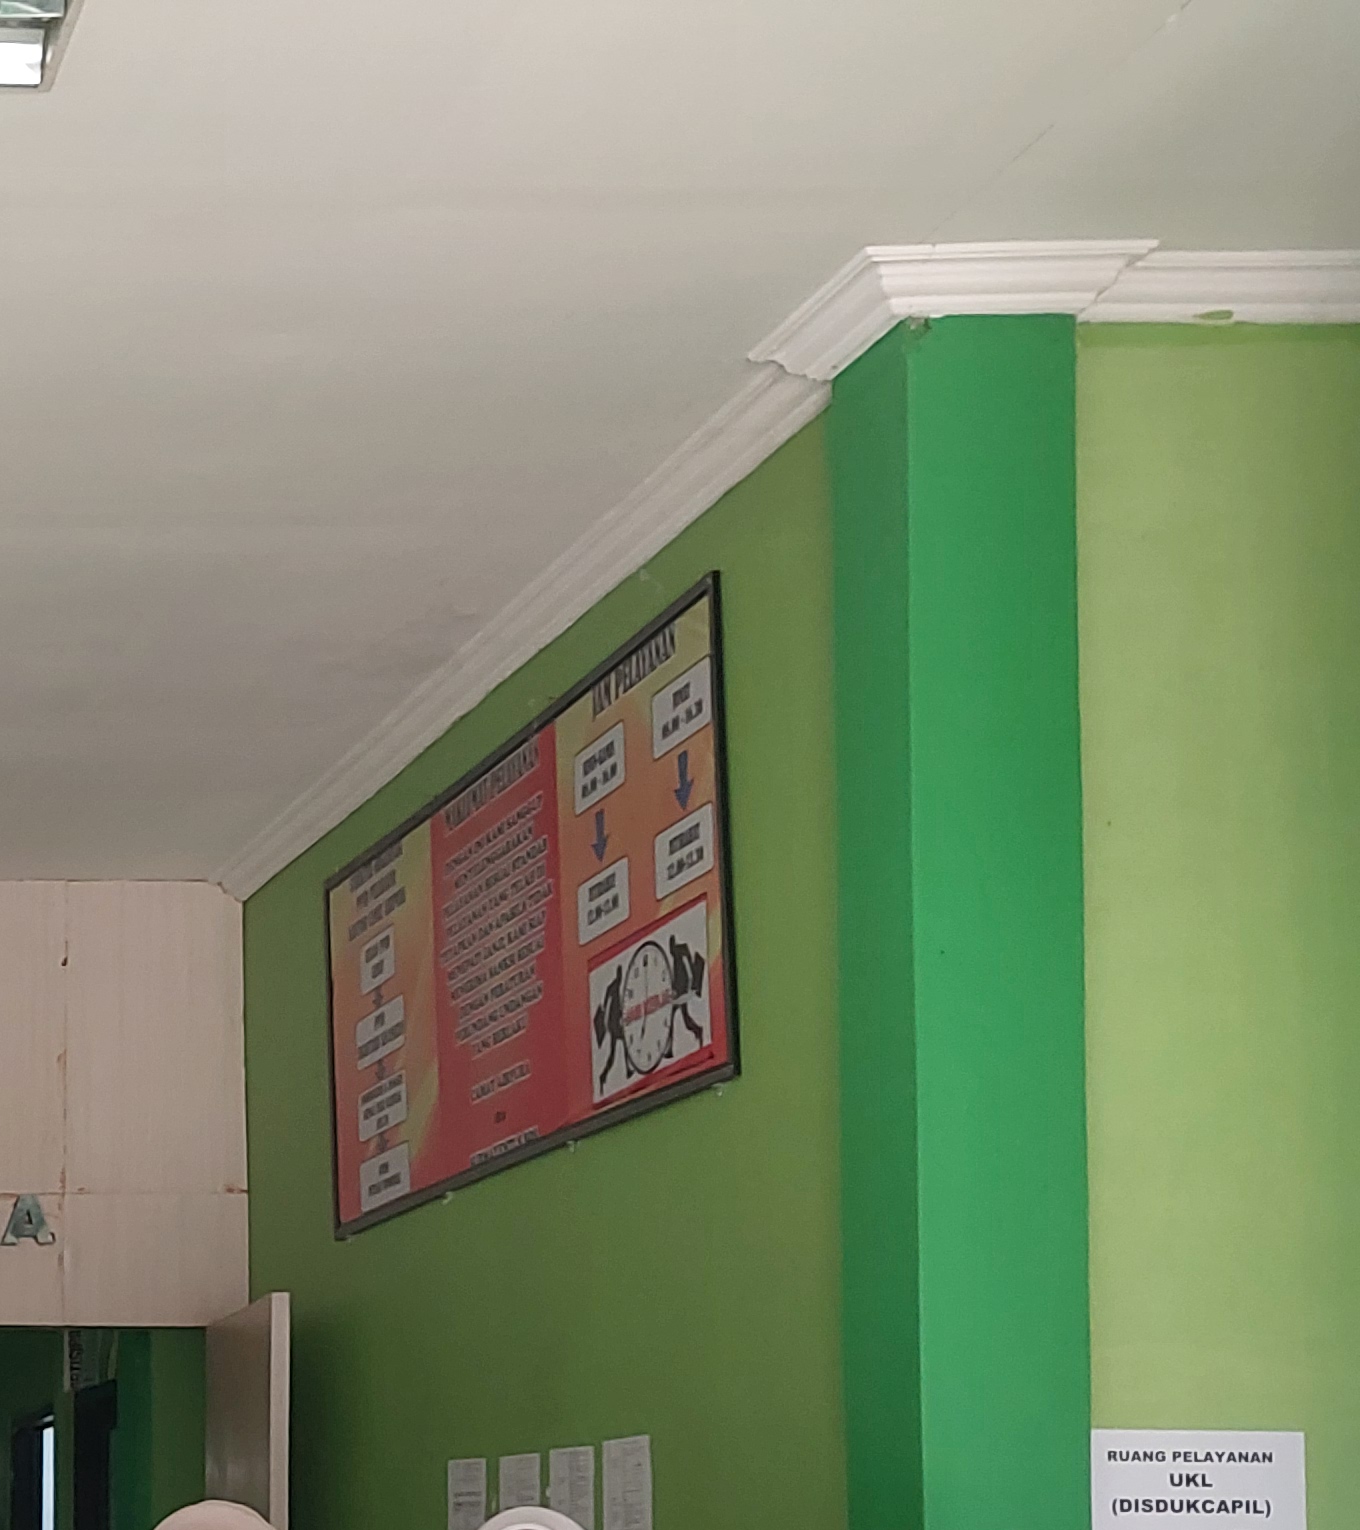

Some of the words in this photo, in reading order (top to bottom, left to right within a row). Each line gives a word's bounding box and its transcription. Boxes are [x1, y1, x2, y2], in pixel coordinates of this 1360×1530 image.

[1107, 1450, 1166, 1463] RUANG
[1172, 1451, 1273, 1464] PELAYANAN
[1169, 1473, 1213, 1488] UKL
[1111, 1498, 1272, 1518] (DISDUKCAPIL)
